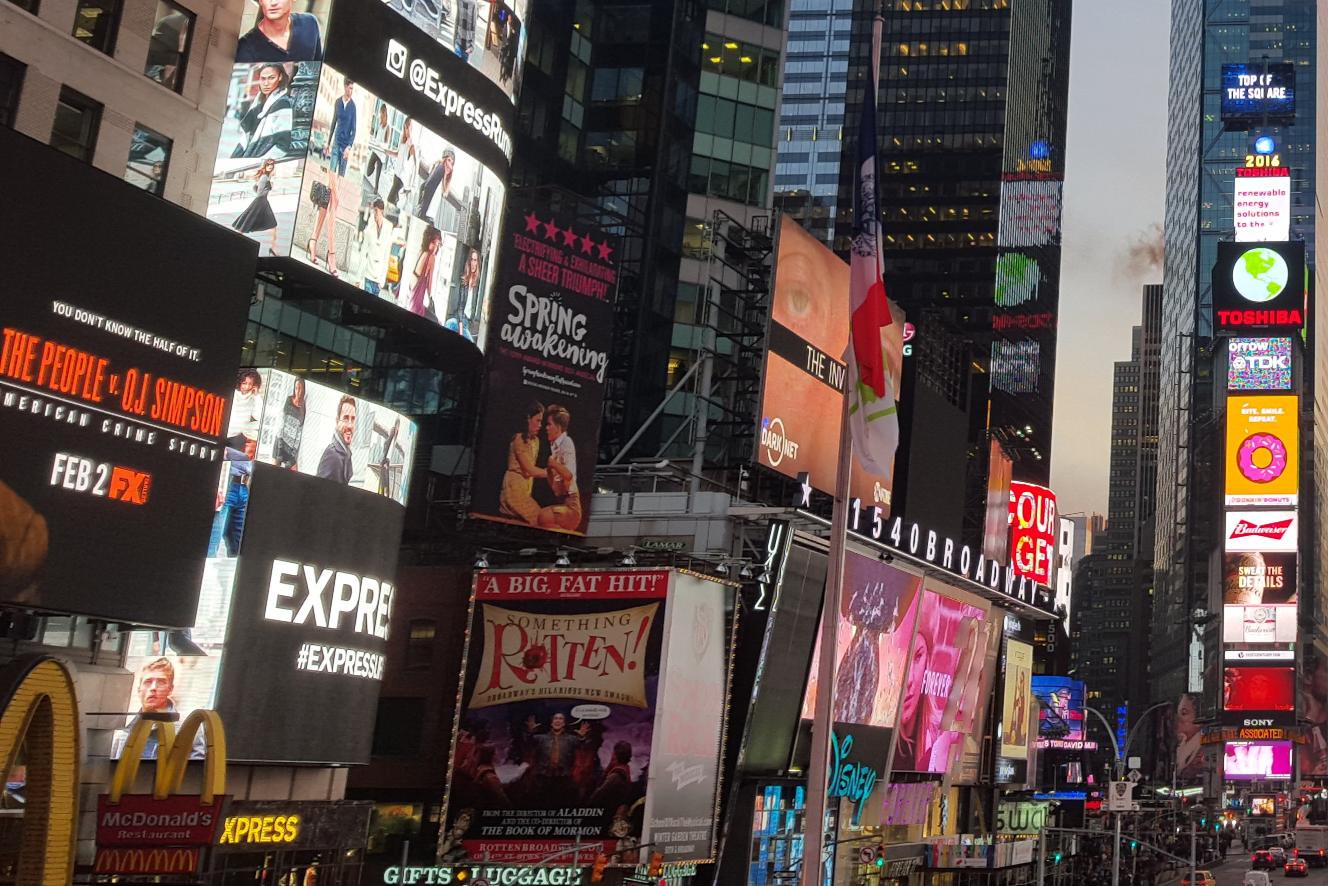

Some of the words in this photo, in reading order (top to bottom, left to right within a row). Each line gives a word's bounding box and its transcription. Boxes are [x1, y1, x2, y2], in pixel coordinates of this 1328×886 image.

[1238, 74, 1257, 86] TOP
[1227, 88, 1245, 100] THE
[1245, 155, 1281, 168] 2016
[1236, 168, 1290, 177] TOSHIBA
[1237, 189, 1286, 197] renewable
[1237, 201, 1269, 209] energy
[1237, 210, 1280, 218] solutions
[1237, 220, 1247, 228] to
[518, 254, 526, 273] A
[527, 256, 560, 285] SHEER
[507, 284, 588, 341] SPRING
[1217, 309, 1302, 326] TOSHIBA
[53, 301, 72, 318] YOU
[75, 308, 104, 328] DON'T
[105, 320, 133, 338] KNOW
[134, 330, 151, 345] THE
[153, 338, 175, 353] HALF
[176, 345, 188, 357] OF
[189, 349, 201, 362] IT.
[500, 323, 609, 383] awakening
[806, 345, 826, 379] THE
[1248, 355, 1288, 369] TDK
[0, 327, 41, 383] THE
[37, 341, 110, 402] PEOPLE
[122, 367, 150, 416] O.J.
[151, 377, 225, 437] SIMPSON
[4, 391, 92, 428] MERICAN
[102, 418, 156, 445] CRIME
[168, 438, 217, 462] STORY
[761, 427, 783, 453] DARK
[783, 440, 799, 460] NET
[50, 452, 92, 492] FEB
[92, 463, 108, 496] 2
[1234, 523, 1288, 535] Budweiser
[1238, 566, 1266, 576] SWEAT
[1267, 566, 1283, 576] THE
[557, 575, 602, 593] FAT
[1238, 575, 1284, 588] DETAILS
[506, 613, 631, 632] SOMETHING
[921, 669, 951, 698] FOREVER
[1243, 718, 1274, 727] SONY
[1239, 728, 1284, 739] ASSOCIATED
[102, 811, 212, 827] McDonald's
[557, 808, 605, 817] ALADDIN
[117, 830, 192, 839] Restaurant
[219, 815, 299, 844] XPRESS
[481, 826, 504, 836] THE
[505, 826, 535, 836] BOOK
[537, 826, 552, 836] OF
[553, 826, 602, 836] MORMON
[384, 866, 453, 885] GIFTS
